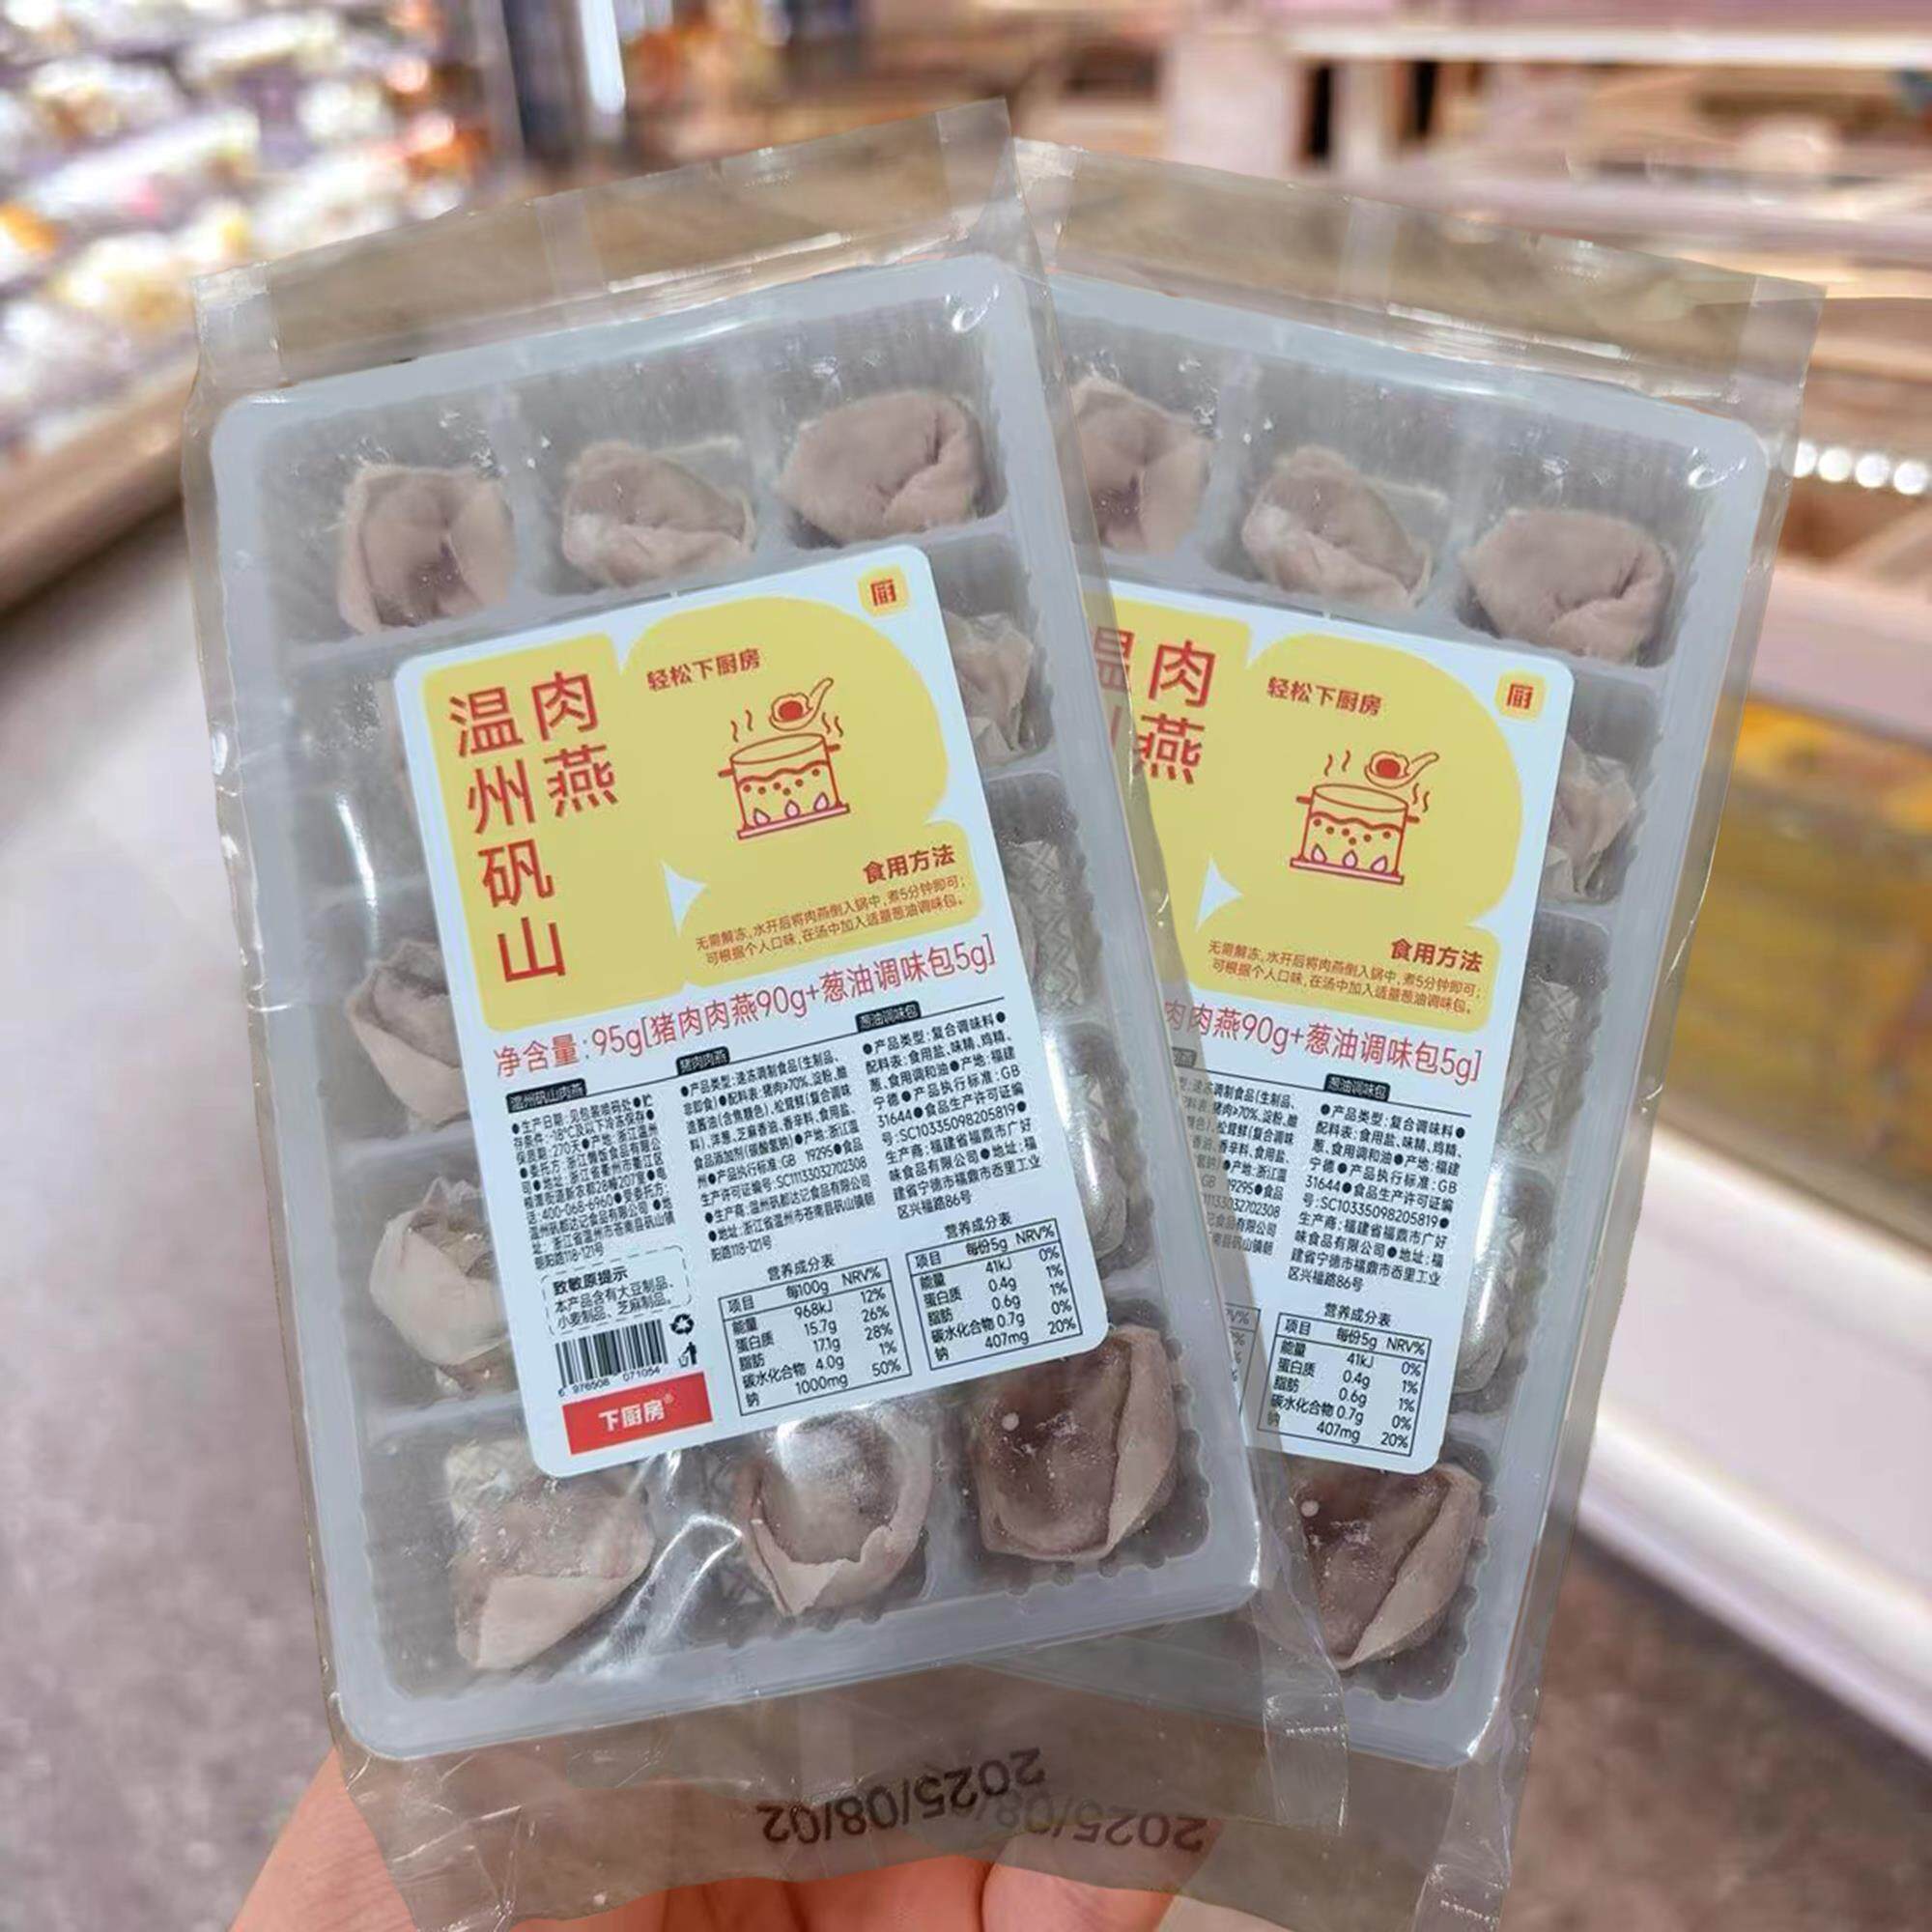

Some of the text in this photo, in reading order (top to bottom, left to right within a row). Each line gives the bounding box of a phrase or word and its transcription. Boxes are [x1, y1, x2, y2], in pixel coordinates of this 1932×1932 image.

[645, 646, 762, 693] 轻松下厨房
[1130, 634, 1218, 785] 肉燕
[1265, 676, 1383, 716] 轻松下厨房
[527, 663, 618, 817] 肉燕
[446, 681, 570, 990] 温州矾山
[861, 842, 956, 885] 食用方法
[1389, 936, 1485, 973] 食用方法
[895, 1188, 973, 1220] 区兴福路86号
[944, 1209, 1012, 1239] 营养成分表
[766, 1251, 835, 1282] 营养成分表
[914, 1223, 1055, 1269] 项目 每份5g NRV%
[919, 1244, 1060, 1291] 能量 41kJ 0%
[553, 1264, 628, 1296] 致敏原提示
[726, 1264, 881, 1314] 项目 每100g NRV%
[923, 1263, 1064, 1308] 蛋白质 0.4g 1%
[1287, 1264, 1364, 1293] 区兴福路86号
[730, 1286, 886, 1336] 能量 968kJ 12%
[926, 1280, 1068, 1326] 脂肪 0.6g 1%
[930, 1297, 1072, 1345] 碳水化合物 0.7g 0%
[1322, 1302, 1392, 1328] 营养成分表
[734, 1303, 890, 1353] 蛋白质 15.7g 26%
[738, 1321, 894, 1372] 脂肪 17.1g 28%
[934, 1315, 1076, 1362] 钠 407mg 20%
[1284, 1318, 1425, 1355] 项目 每份5g NRV%
[741, 1339, 897, 1390] 碳水化合物 4.0g 1%
[1276, 1356, 1418, 1395] 蛋白质 0.4g 1%
[1279, 1339, 1422, 1378] 能量 41kJ 0%
[745, 1356, 901, 1407] 钠 1000mg 50%
[1272, 1374, 1415, 1413] 脂肪 0.6g 1%
[597, 1396, 665, 1435] 下厨房
[1269, 1391, 1412, 1431] 碳水化合物 0.7g 0%
[1315, 1420, 1361, 1444] 407mg
[1379, 1431, 1408, 1449] 20%
[756, 1747, 1046, 1844] 2025/08/02
